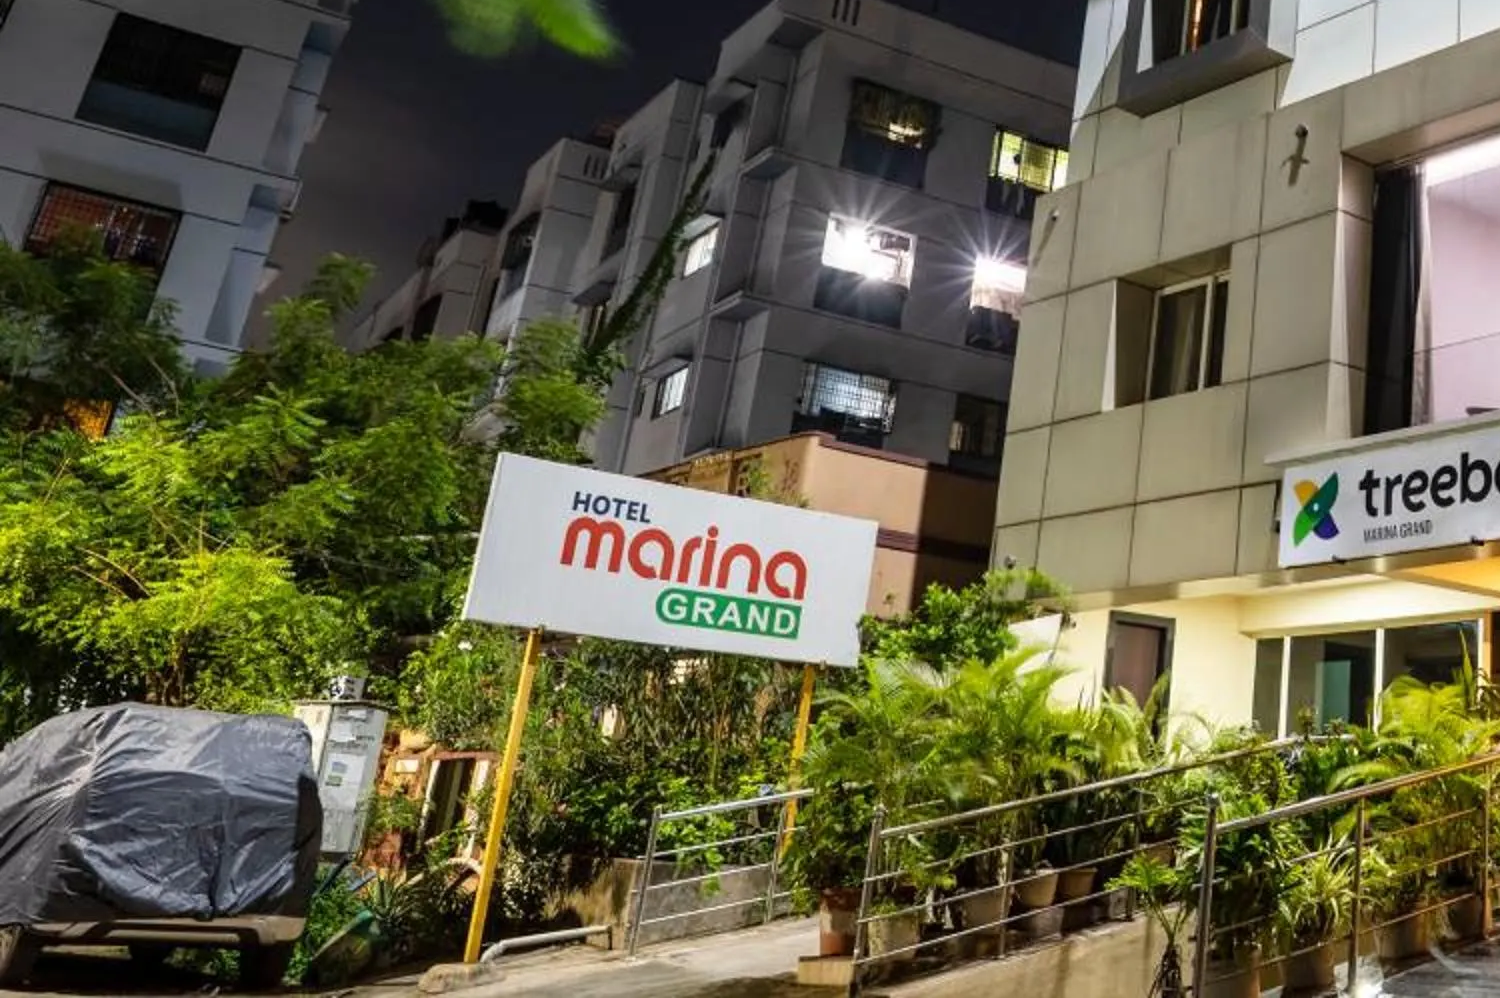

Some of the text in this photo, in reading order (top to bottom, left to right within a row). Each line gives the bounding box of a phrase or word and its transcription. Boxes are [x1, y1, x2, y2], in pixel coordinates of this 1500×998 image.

[572, 491, 651, 523] HOTEL
[1363, 519, 1432, 543] MARINA GRAND
[560, 516, 808, 600] marina
[661, 593, 797, 634] GRAND
